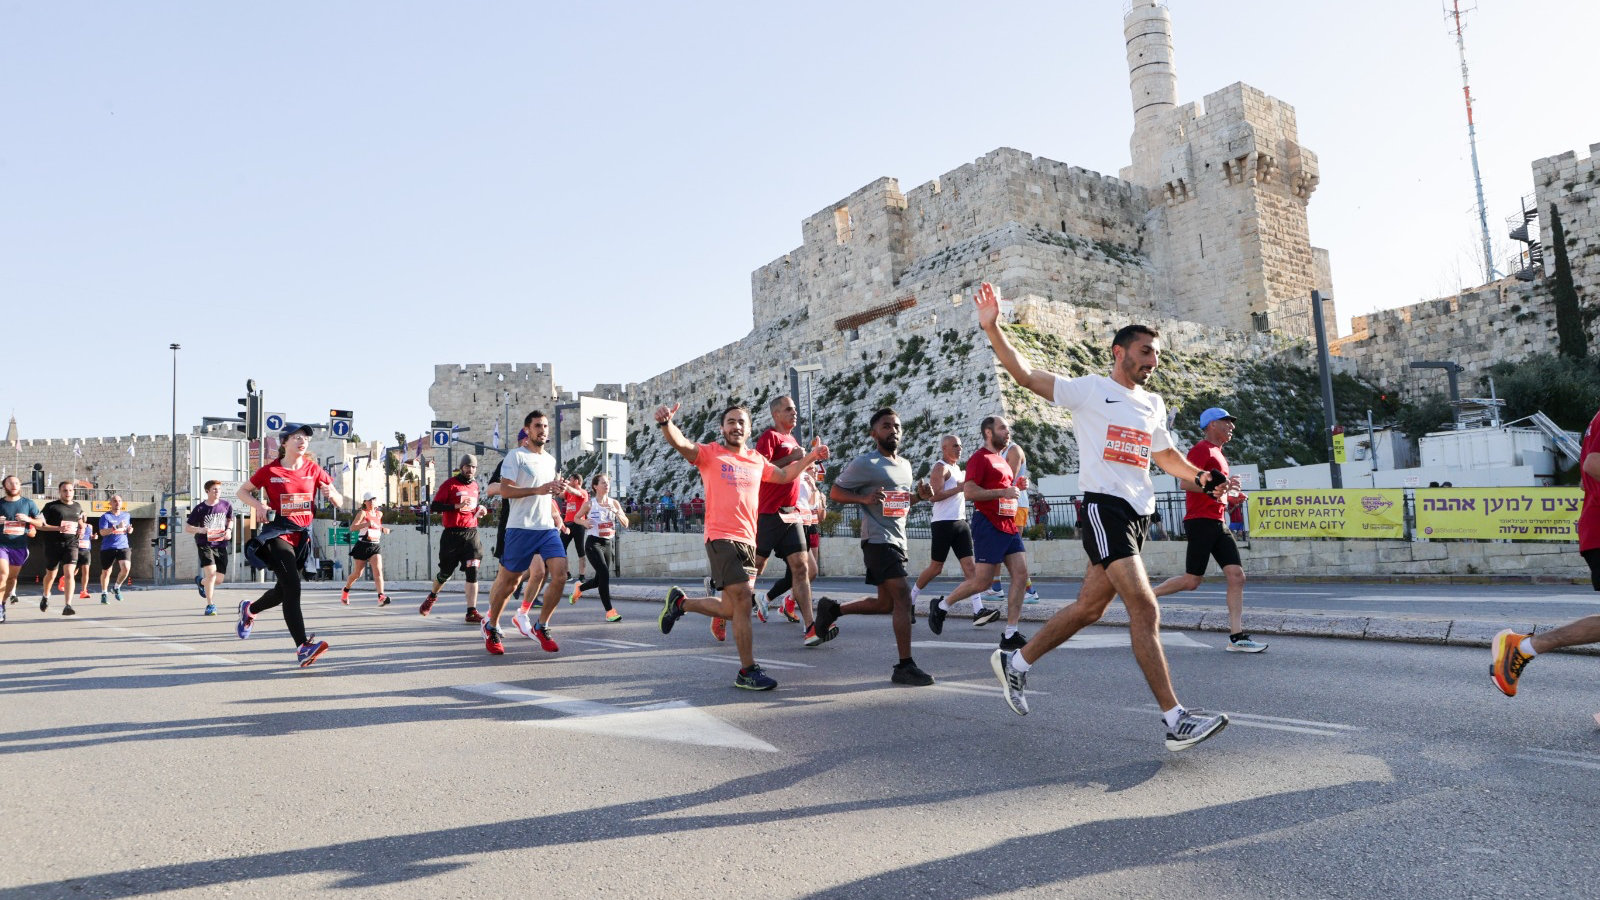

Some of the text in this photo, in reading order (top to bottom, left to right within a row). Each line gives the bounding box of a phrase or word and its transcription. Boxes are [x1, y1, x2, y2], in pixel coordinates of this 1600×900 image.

[1258, 495, 1346, 506] TEAM SHALVA
[1423, 498, 1476, 511] אהבה
[1483, 495, 1534, 516] למען
[1258, 508, 1346, 518] VICTORY PARTY
[1259, 521, 1346, 530] AT CINEMA CITY
[1499, 525, 1571, 534] נבחרת שלוה
